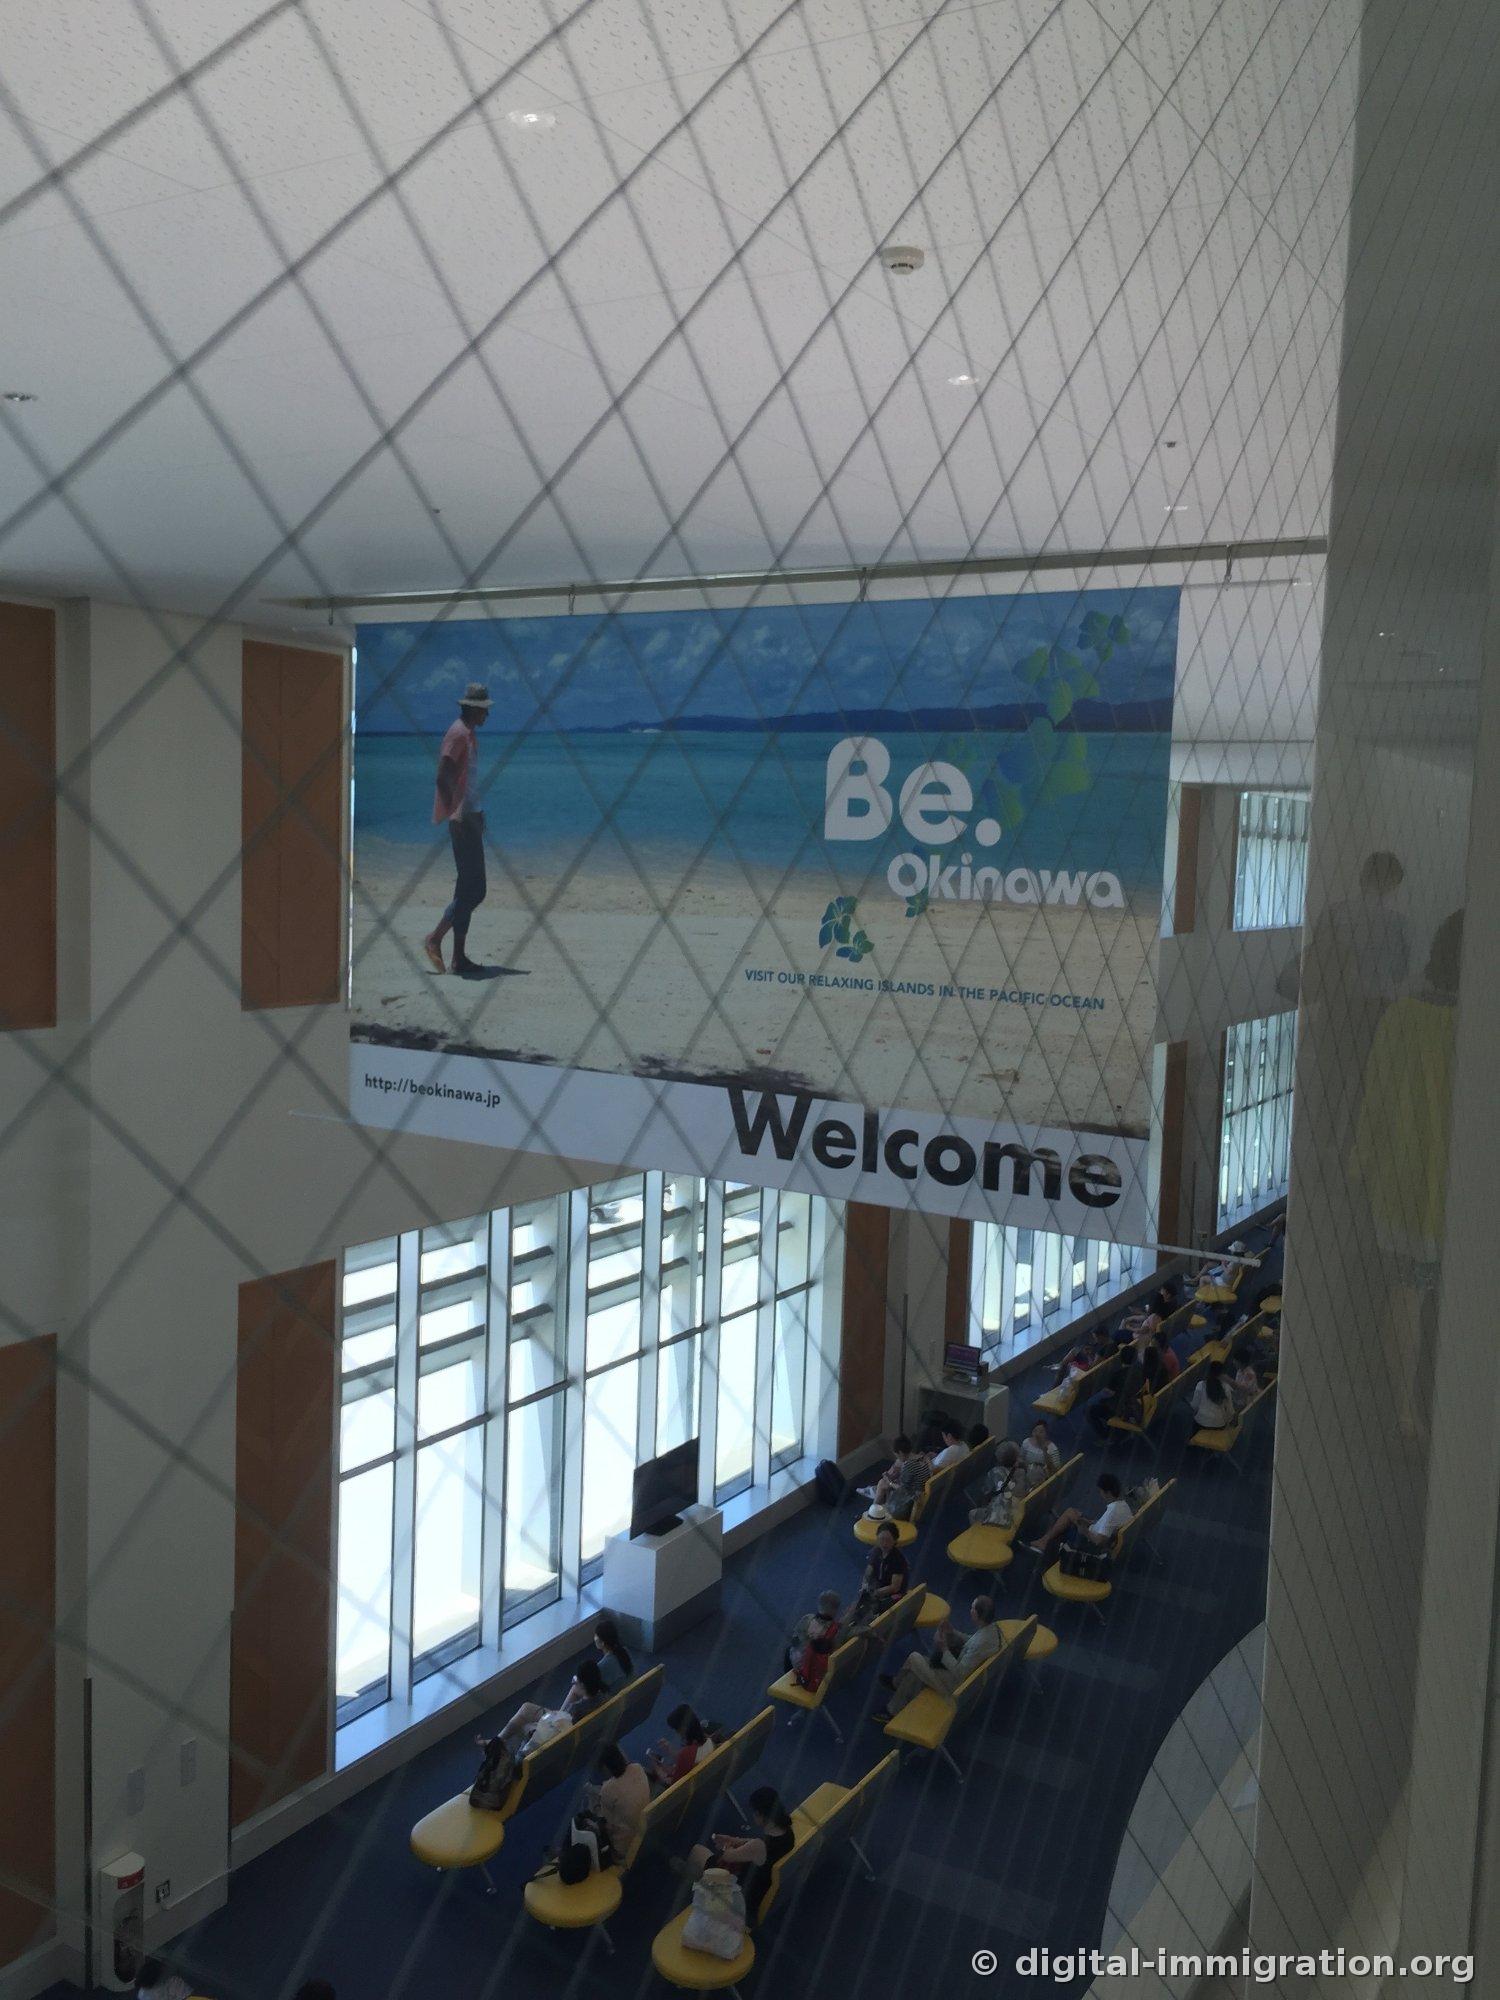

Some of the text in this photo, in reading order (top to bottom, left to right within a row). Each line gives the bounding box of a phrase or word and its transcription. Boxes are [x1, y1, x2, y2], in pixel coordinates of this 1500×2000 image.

[824, 736, 1001, 847] Be.
[887, 852, 1125, 908] Okinawa
[744, 968, 1105, 1010] VISIT OUR RELAXING ISLANDS IN THE PACIFIC OCEAN
[364, 1073, 501, 1108] http://beokinawa.jp
[727, 1087, 1122, 1209] Welcome
